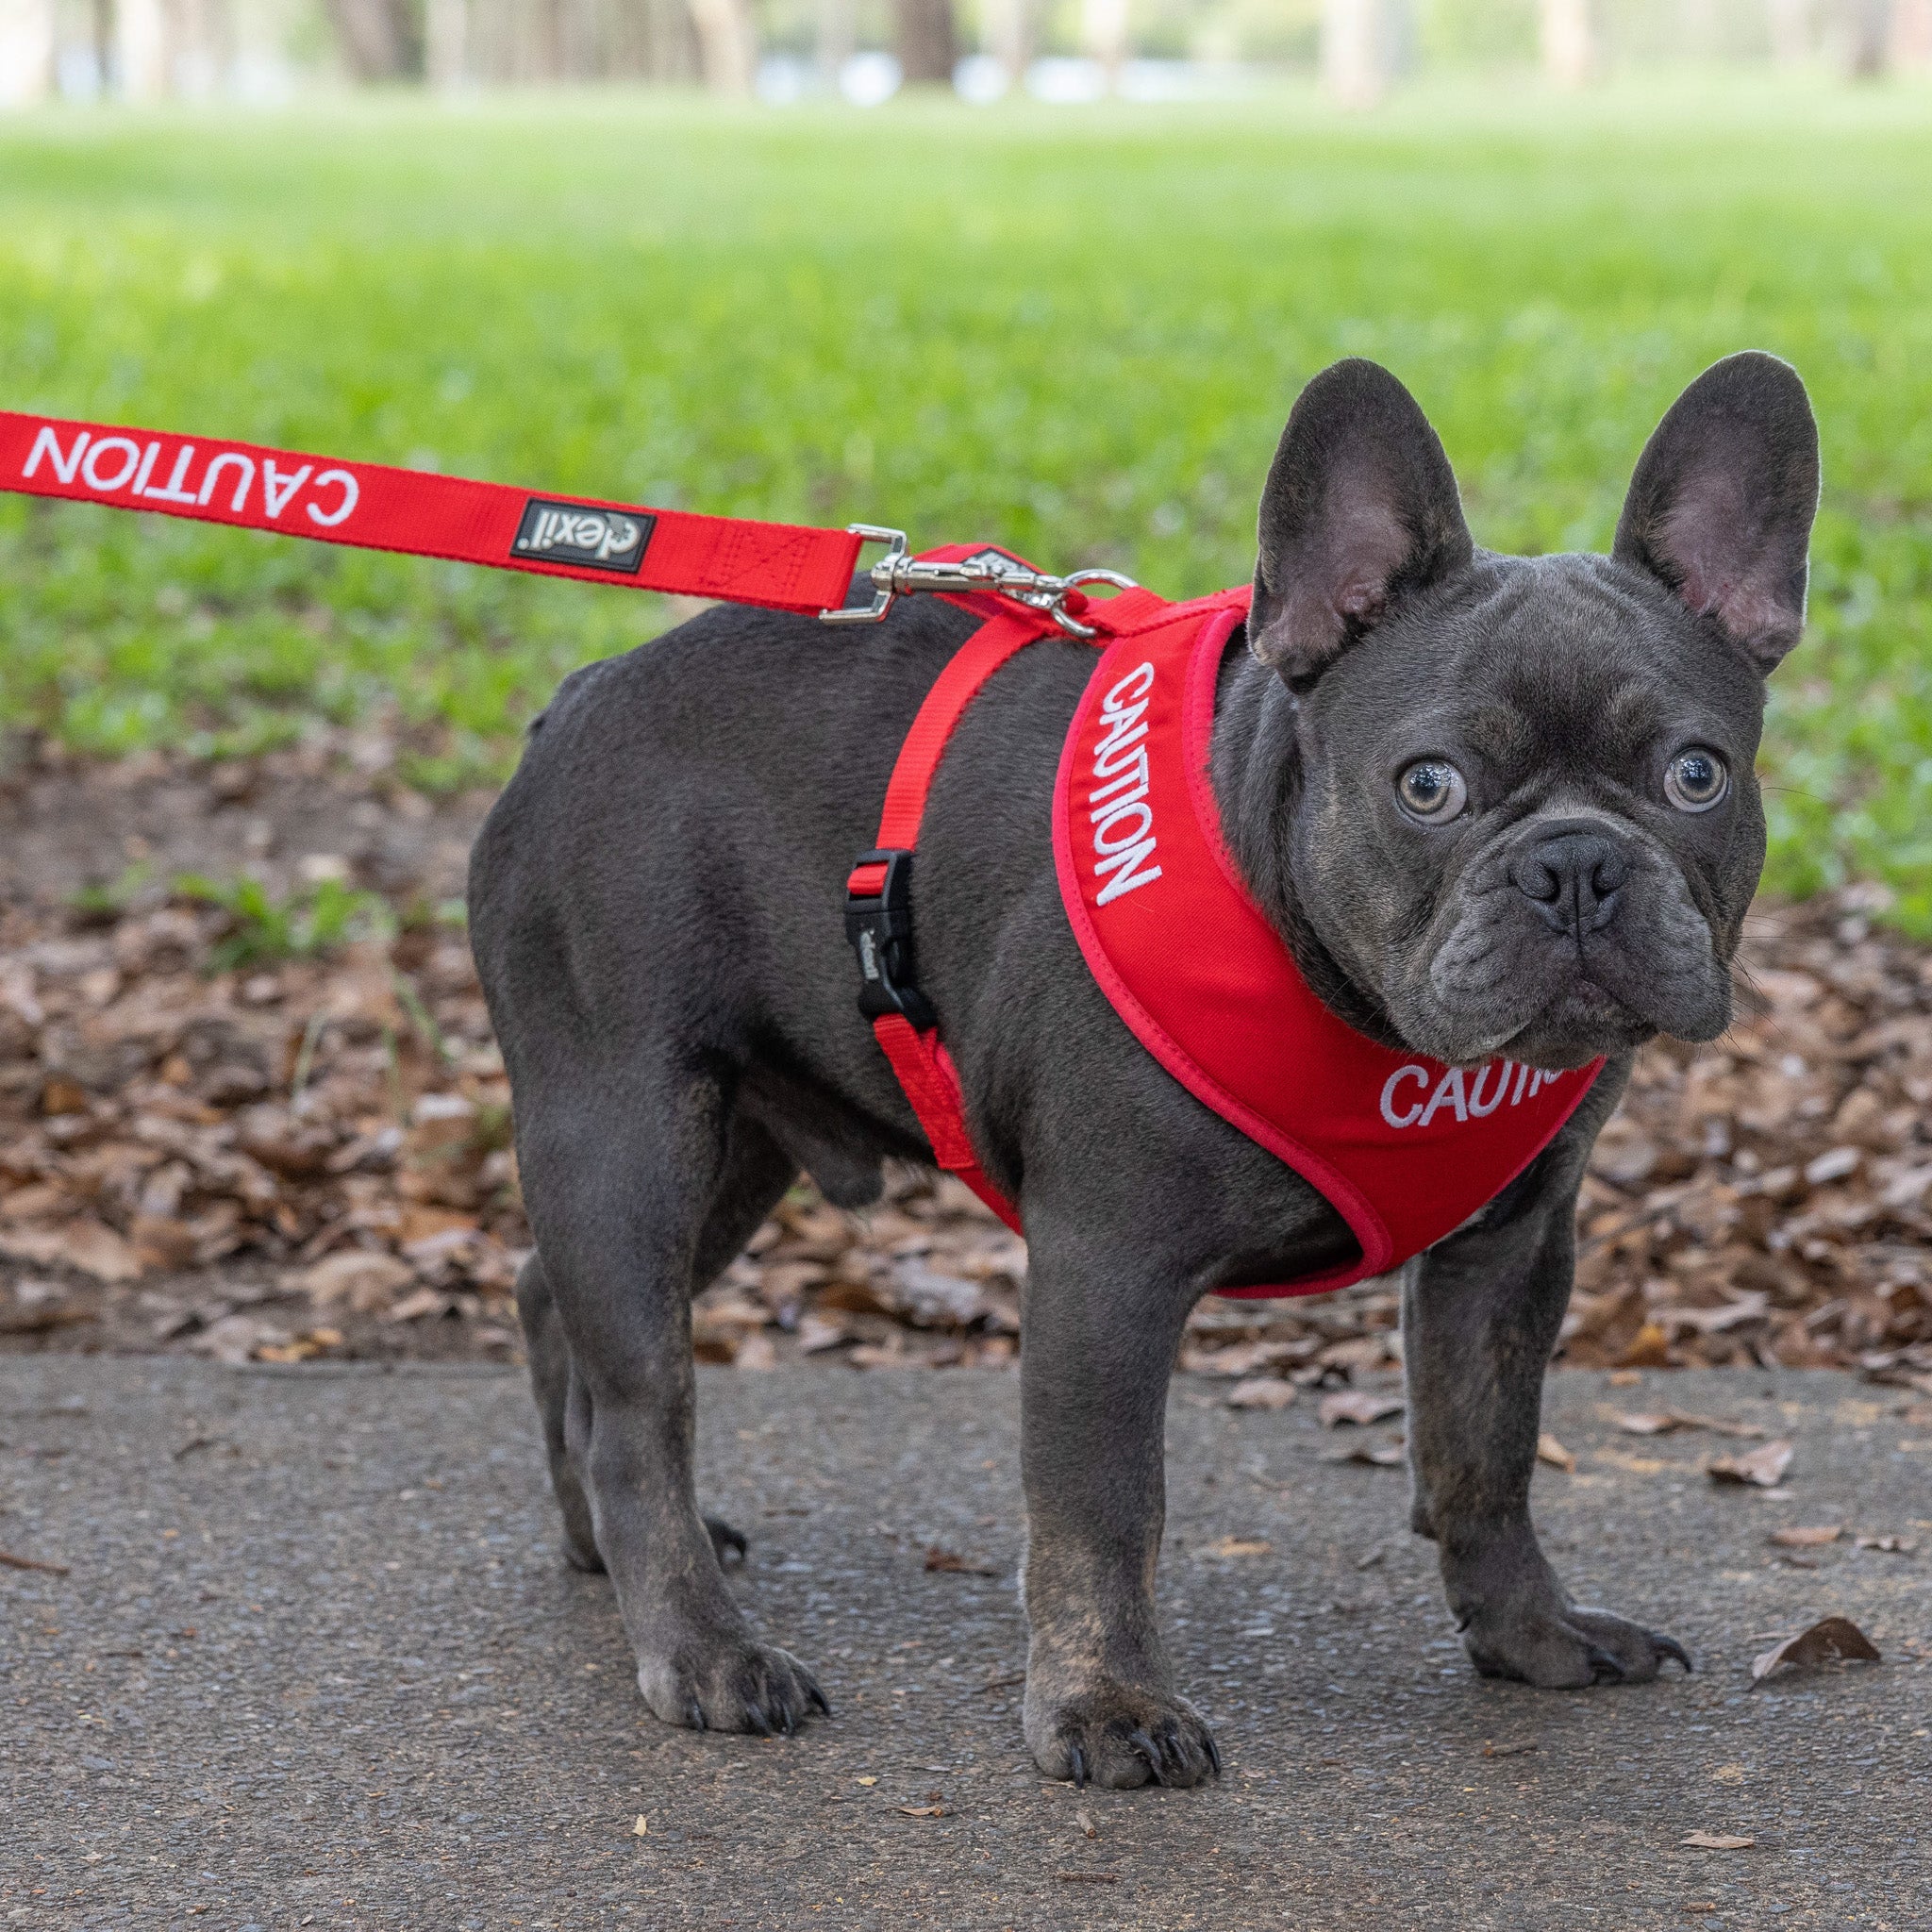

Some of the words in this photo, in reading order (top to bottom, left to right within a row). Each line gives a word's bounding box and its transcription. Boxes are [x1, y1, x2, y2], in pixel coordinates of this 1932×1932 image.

[22, 425, 359, 526] CAUTION
[528, 508, 641, 561] dexil
[1089, 661, 1163, 907] CAUTION
